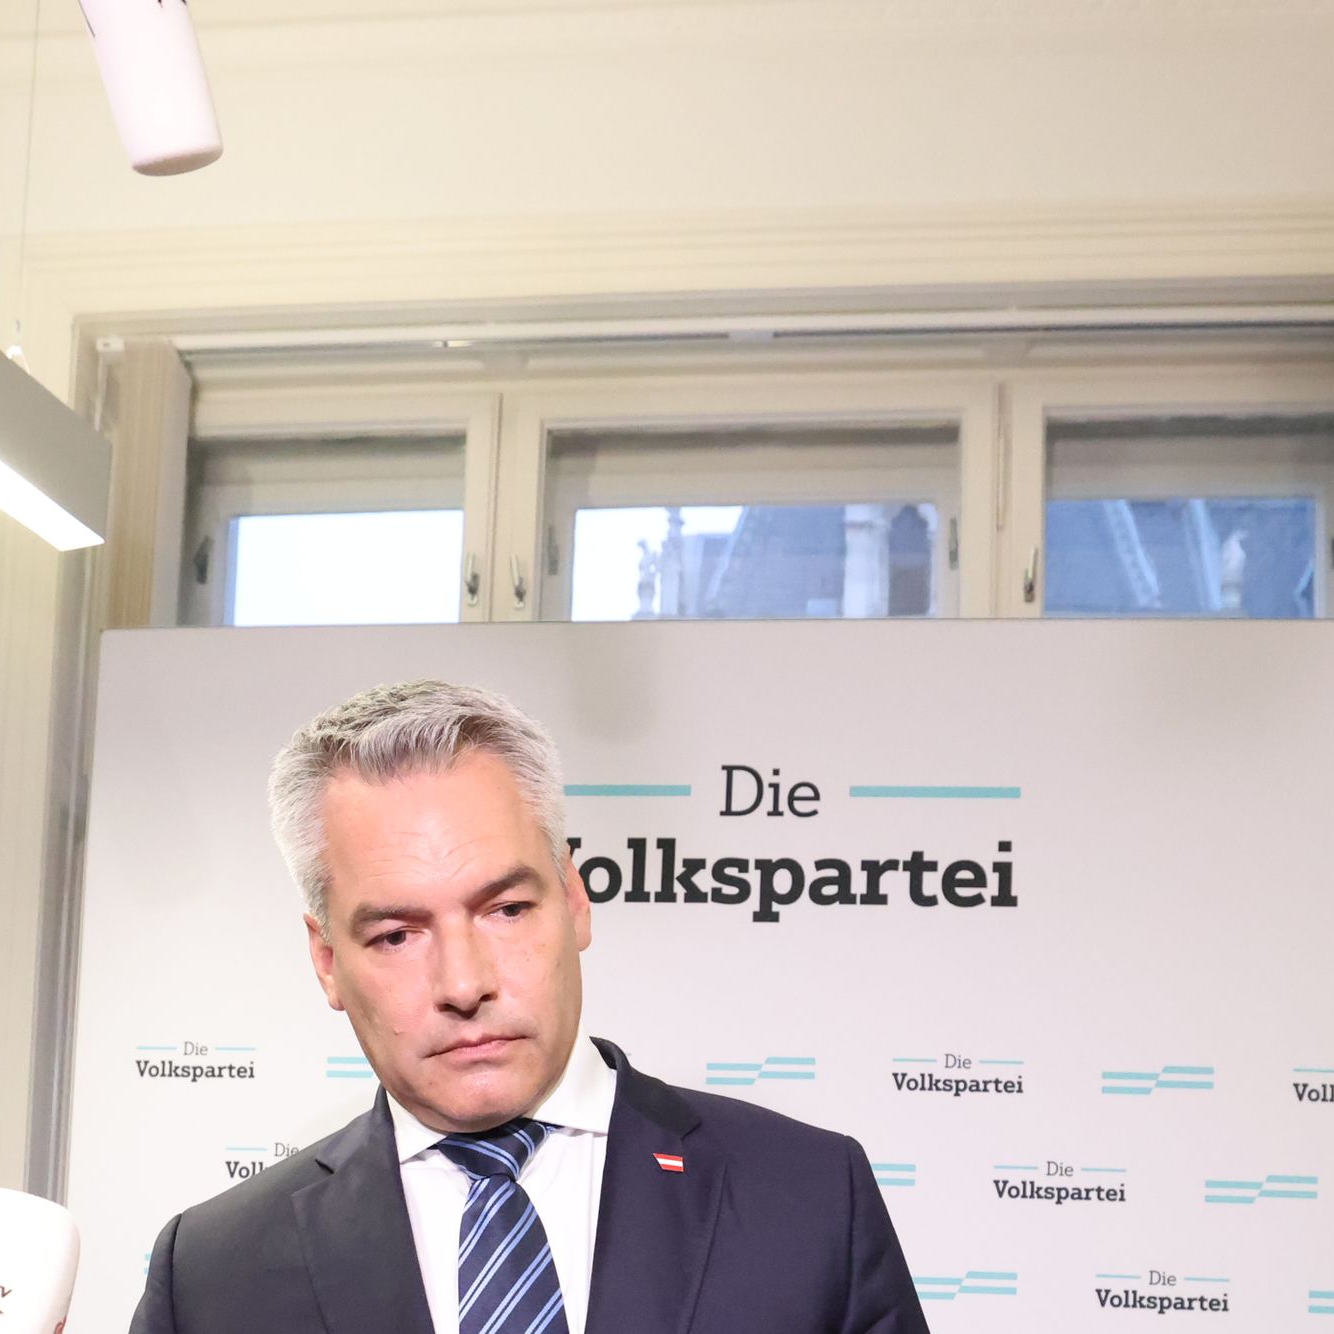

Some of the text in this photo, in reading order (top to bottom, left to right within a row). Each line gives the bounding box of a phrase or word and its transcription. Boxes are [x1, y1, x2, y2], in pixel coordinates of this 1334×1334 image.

[719, 765, 821, 818] Die
[566, 837, 1018, 923] olkspartei
[183, 1041, 209, 1056] Die
[136, 1060, 255, 1082] Volkspartei
[944, 1054, 972, 1070] Die
[892, 1072, 1024, 1096] Volkspartei
[1046, 1160, 1074, 1178] Die
[993, 1180, 1126, 1205] Volkspartei
[1149, 1270, 1177, 1287] Die
[1095, 1289, 1229, 1314] Volkspartei
